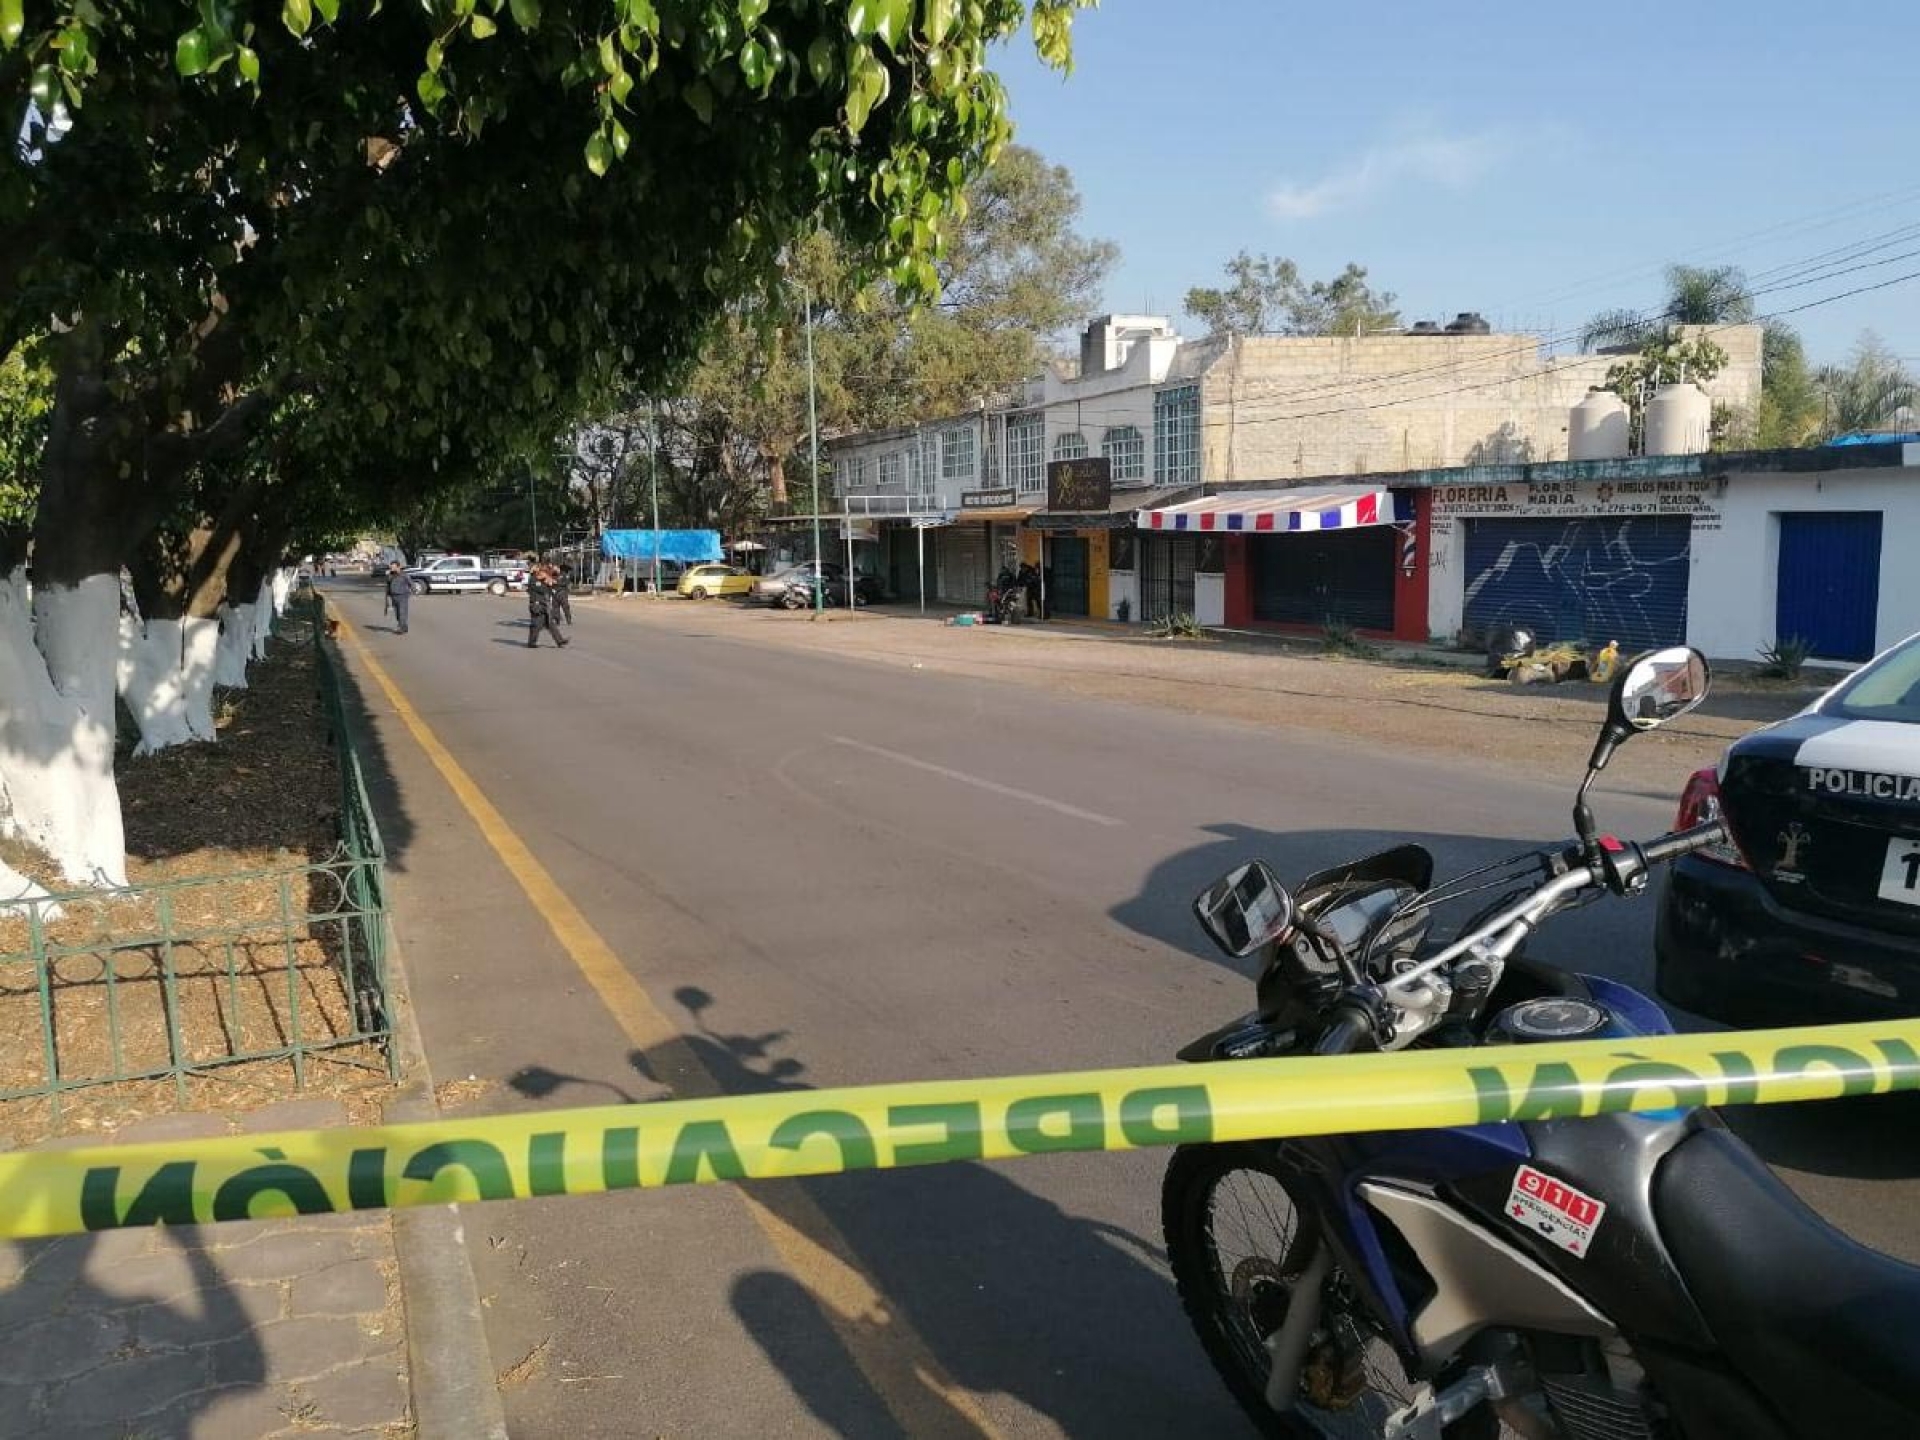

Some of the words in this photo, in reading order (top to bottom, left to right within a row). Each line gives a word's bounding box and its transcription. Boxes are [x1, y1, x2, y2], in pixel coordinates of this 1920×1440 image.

[1432, 486, 1508, 503] FLORERIA
[1527, 493, 1575, 505] MARIA
[1808, 768, 1920, 800] POLICIA
[1523, 1175, 1590, 1220] 911
